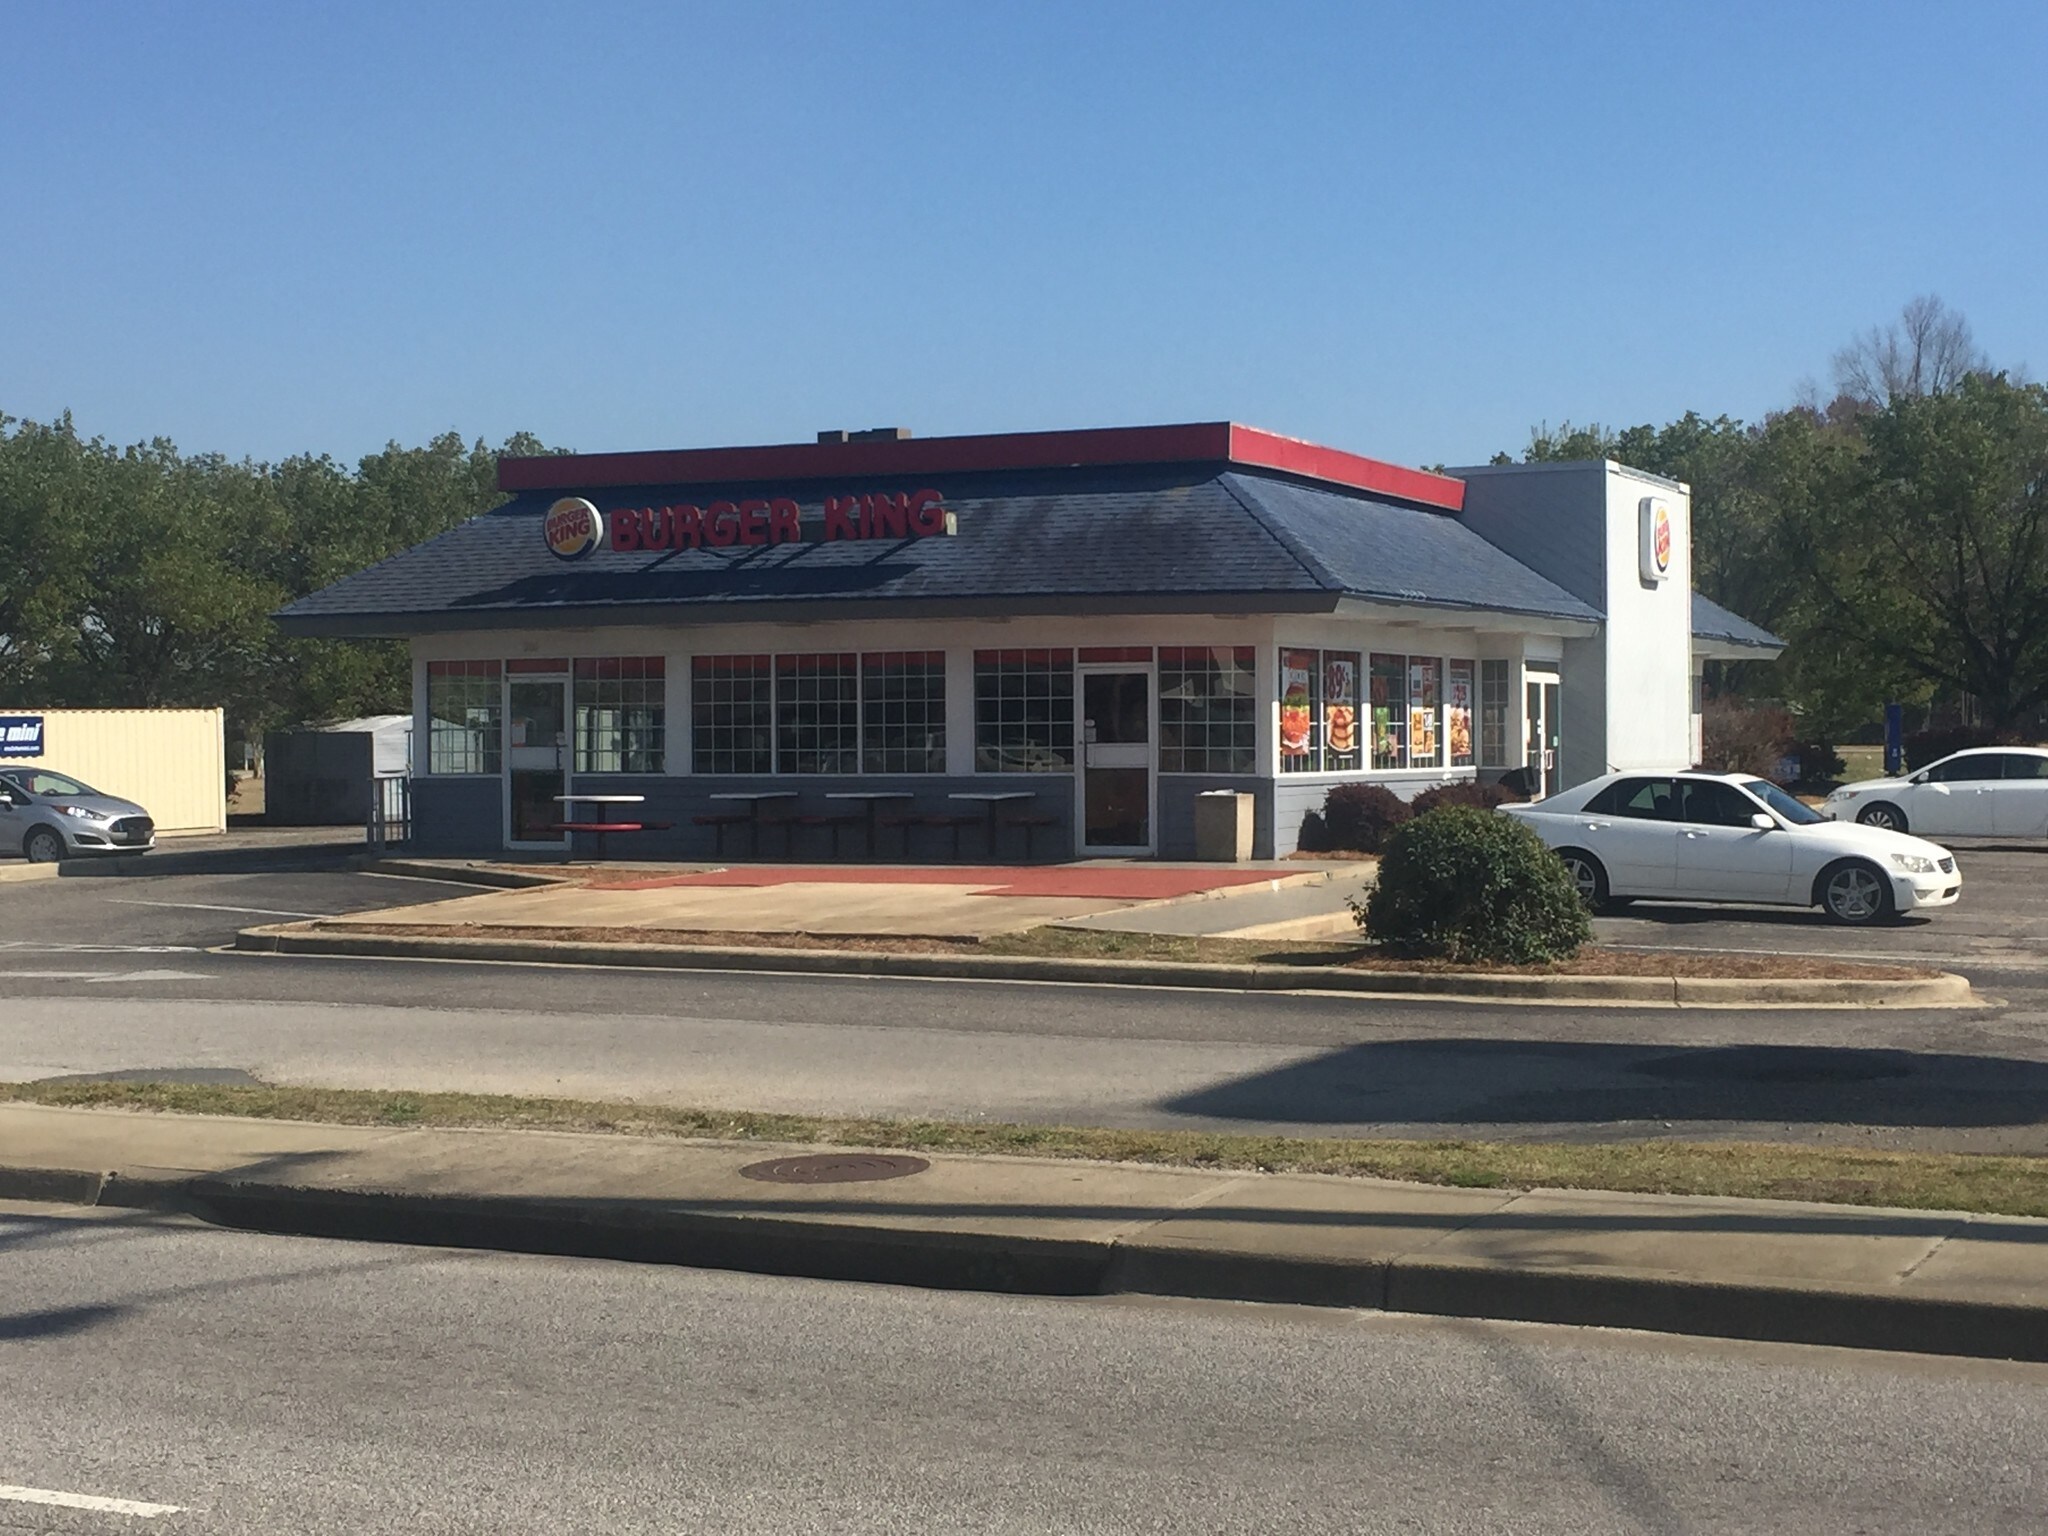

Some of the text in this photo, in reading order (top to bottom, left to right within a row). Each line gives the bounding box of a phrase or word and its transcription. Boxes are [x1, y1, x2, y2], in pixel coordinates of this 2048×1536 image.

[547, 508, 589, 532] BURGER
[549, 519, 591, 546] KING
[610, 488, 946, 552] BURGER KING
[6, 723, 42, 742] mini
